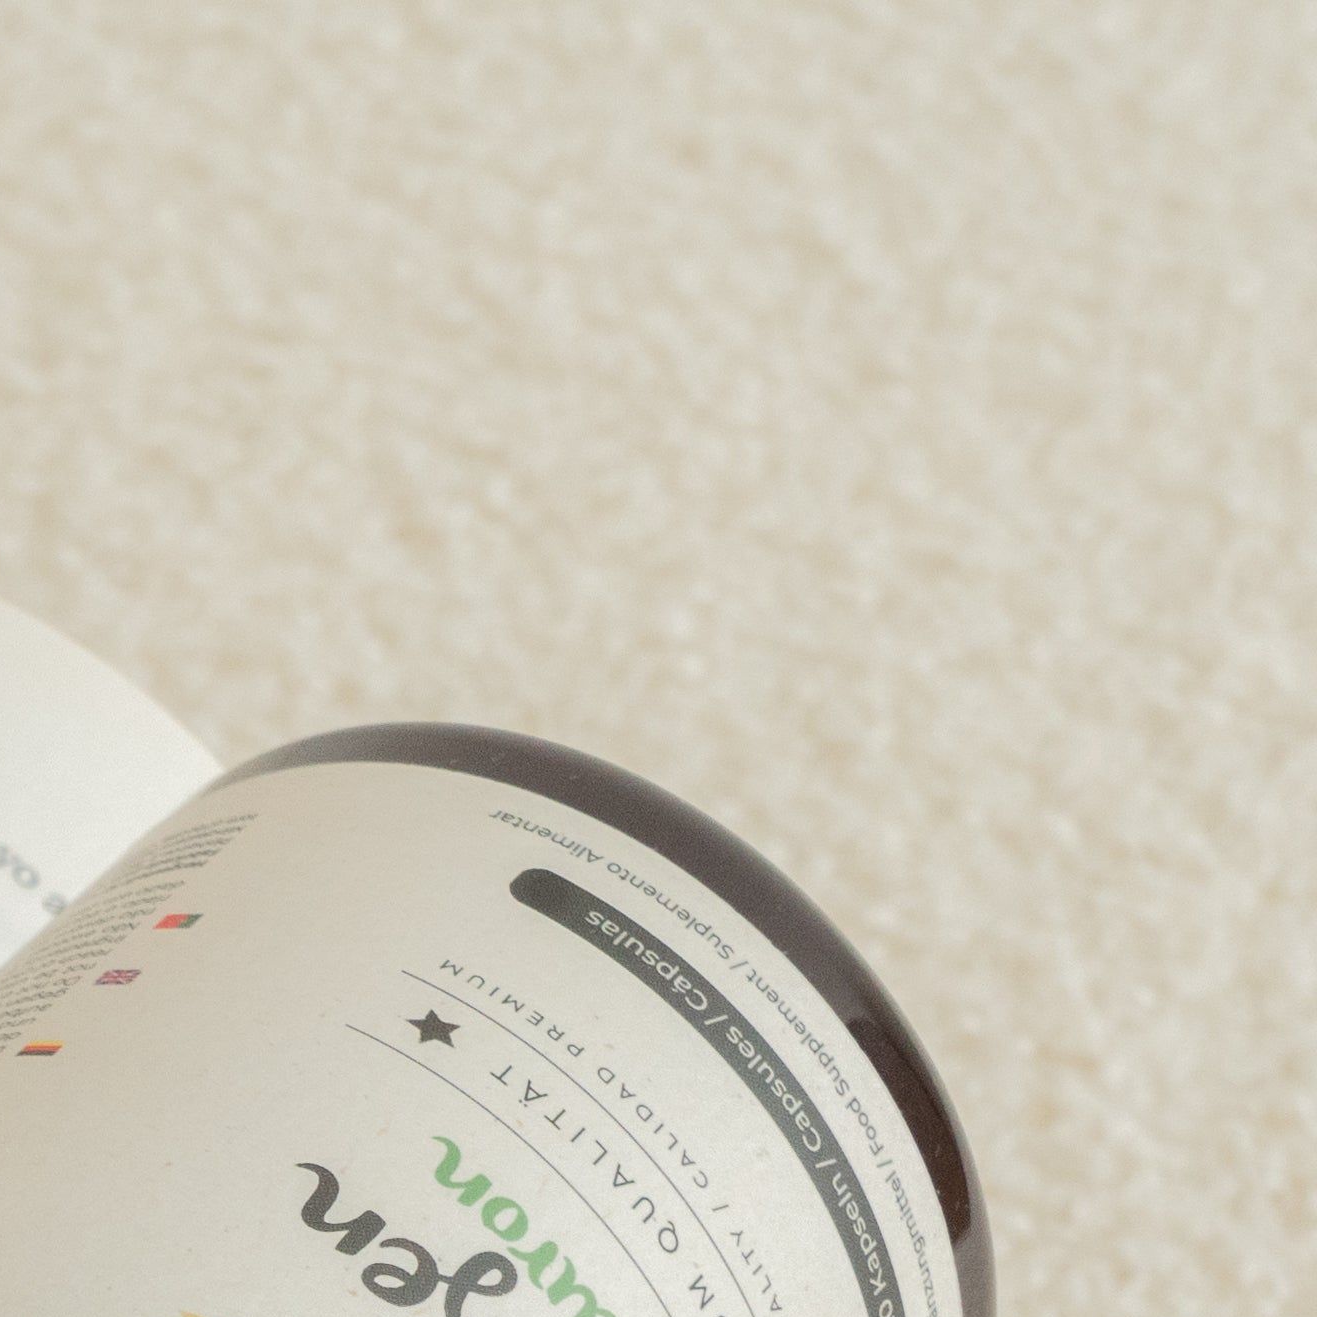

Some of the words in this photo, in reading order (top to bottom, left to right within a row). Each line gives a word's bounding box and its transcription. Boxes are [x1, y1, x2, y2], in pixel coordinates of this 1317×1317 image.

[487, 807, 606, 866] Alimentar
[583, 908, 709, 1012] Cápsulas
[605, 861, 735, 962] Suplemento
[438, 958, 586, 1058] PREMIUM
[745, 967, 851, 1097] Supplement
[596, 1065, 709, 1189] CALIDAD
[724, 1024, 823, 1153] Capsules
[844, 1095, 886, 1158] Food
[489, 1064, 680, 1254] QUALITÄT
[830, 1171, 888, 1297] Kapseln
